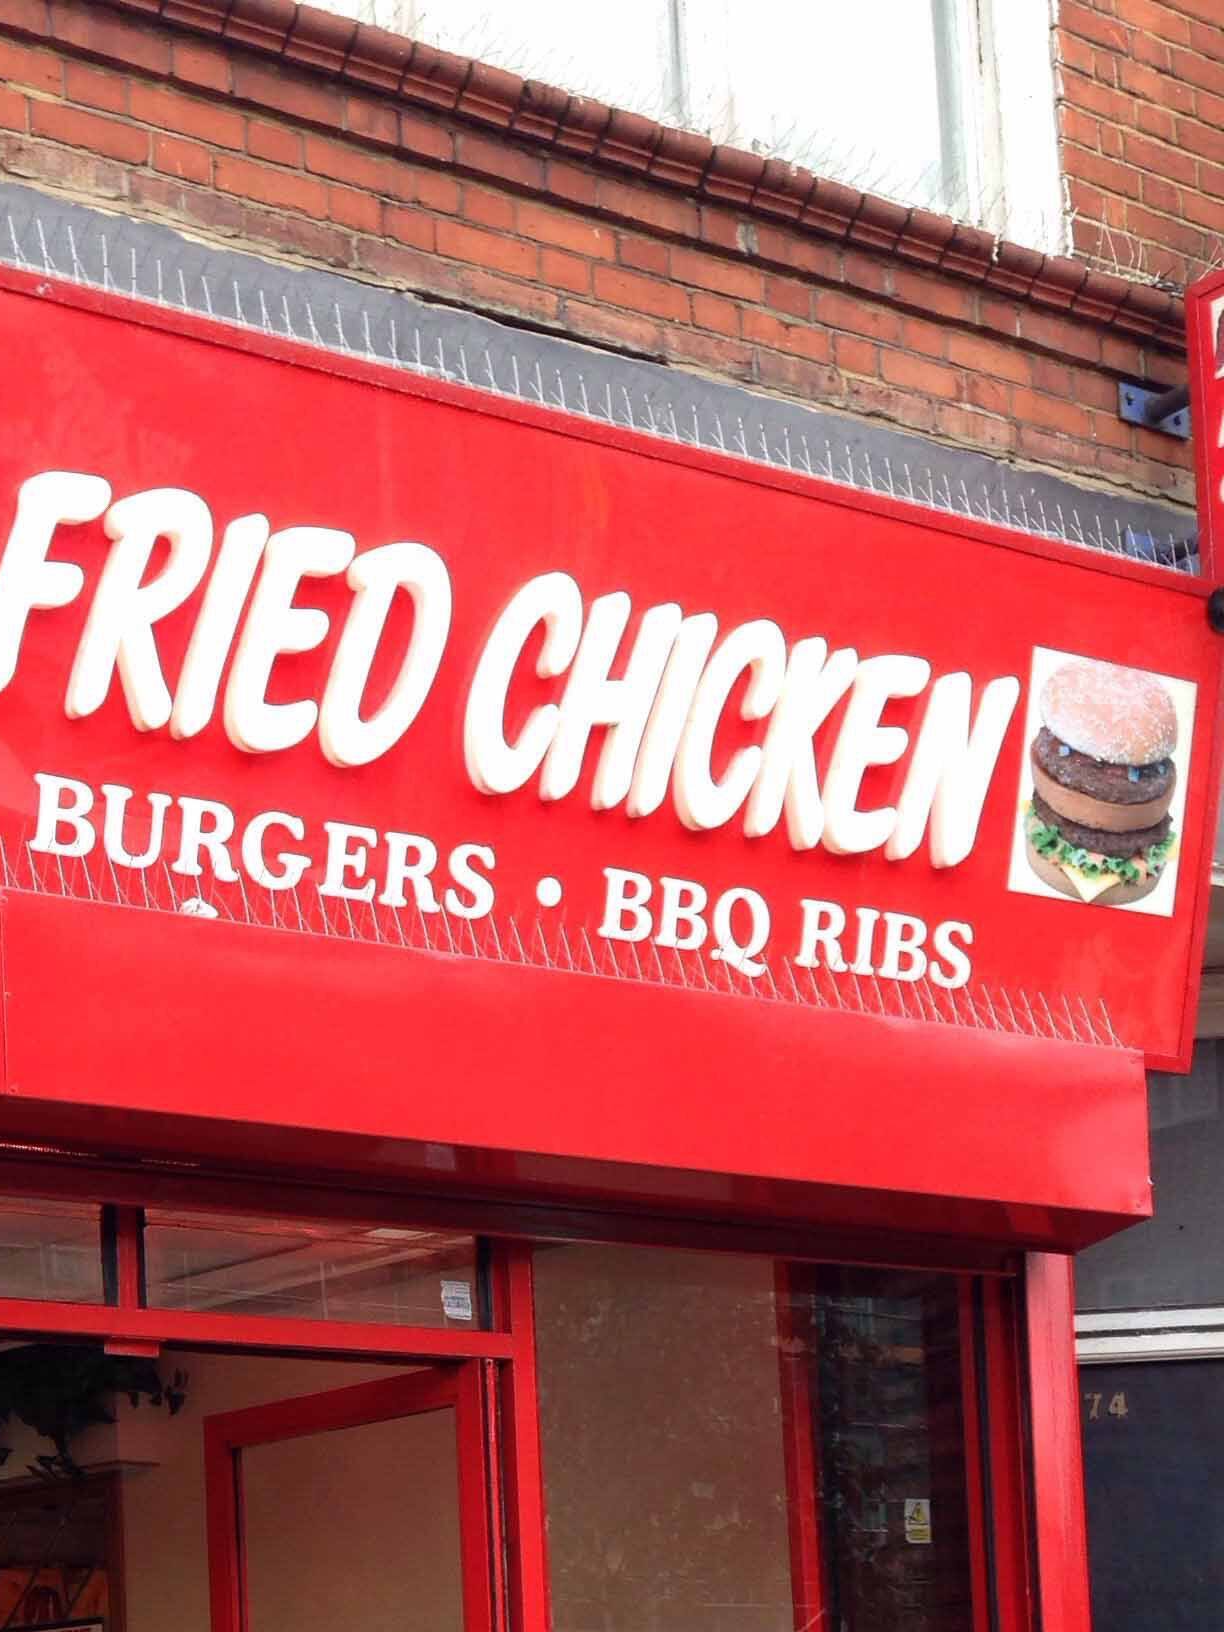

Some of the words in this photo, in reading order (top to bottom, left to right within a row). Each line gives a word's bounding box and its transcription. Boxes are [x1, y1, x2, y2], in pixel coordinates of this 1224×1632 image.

[464, 571, 1021, 870] CHICKEN
[29, 772, 496, 921] BURGERS
[599, 867, 773, 979] BBQ
[794, 898, 975, 990] RIBS
